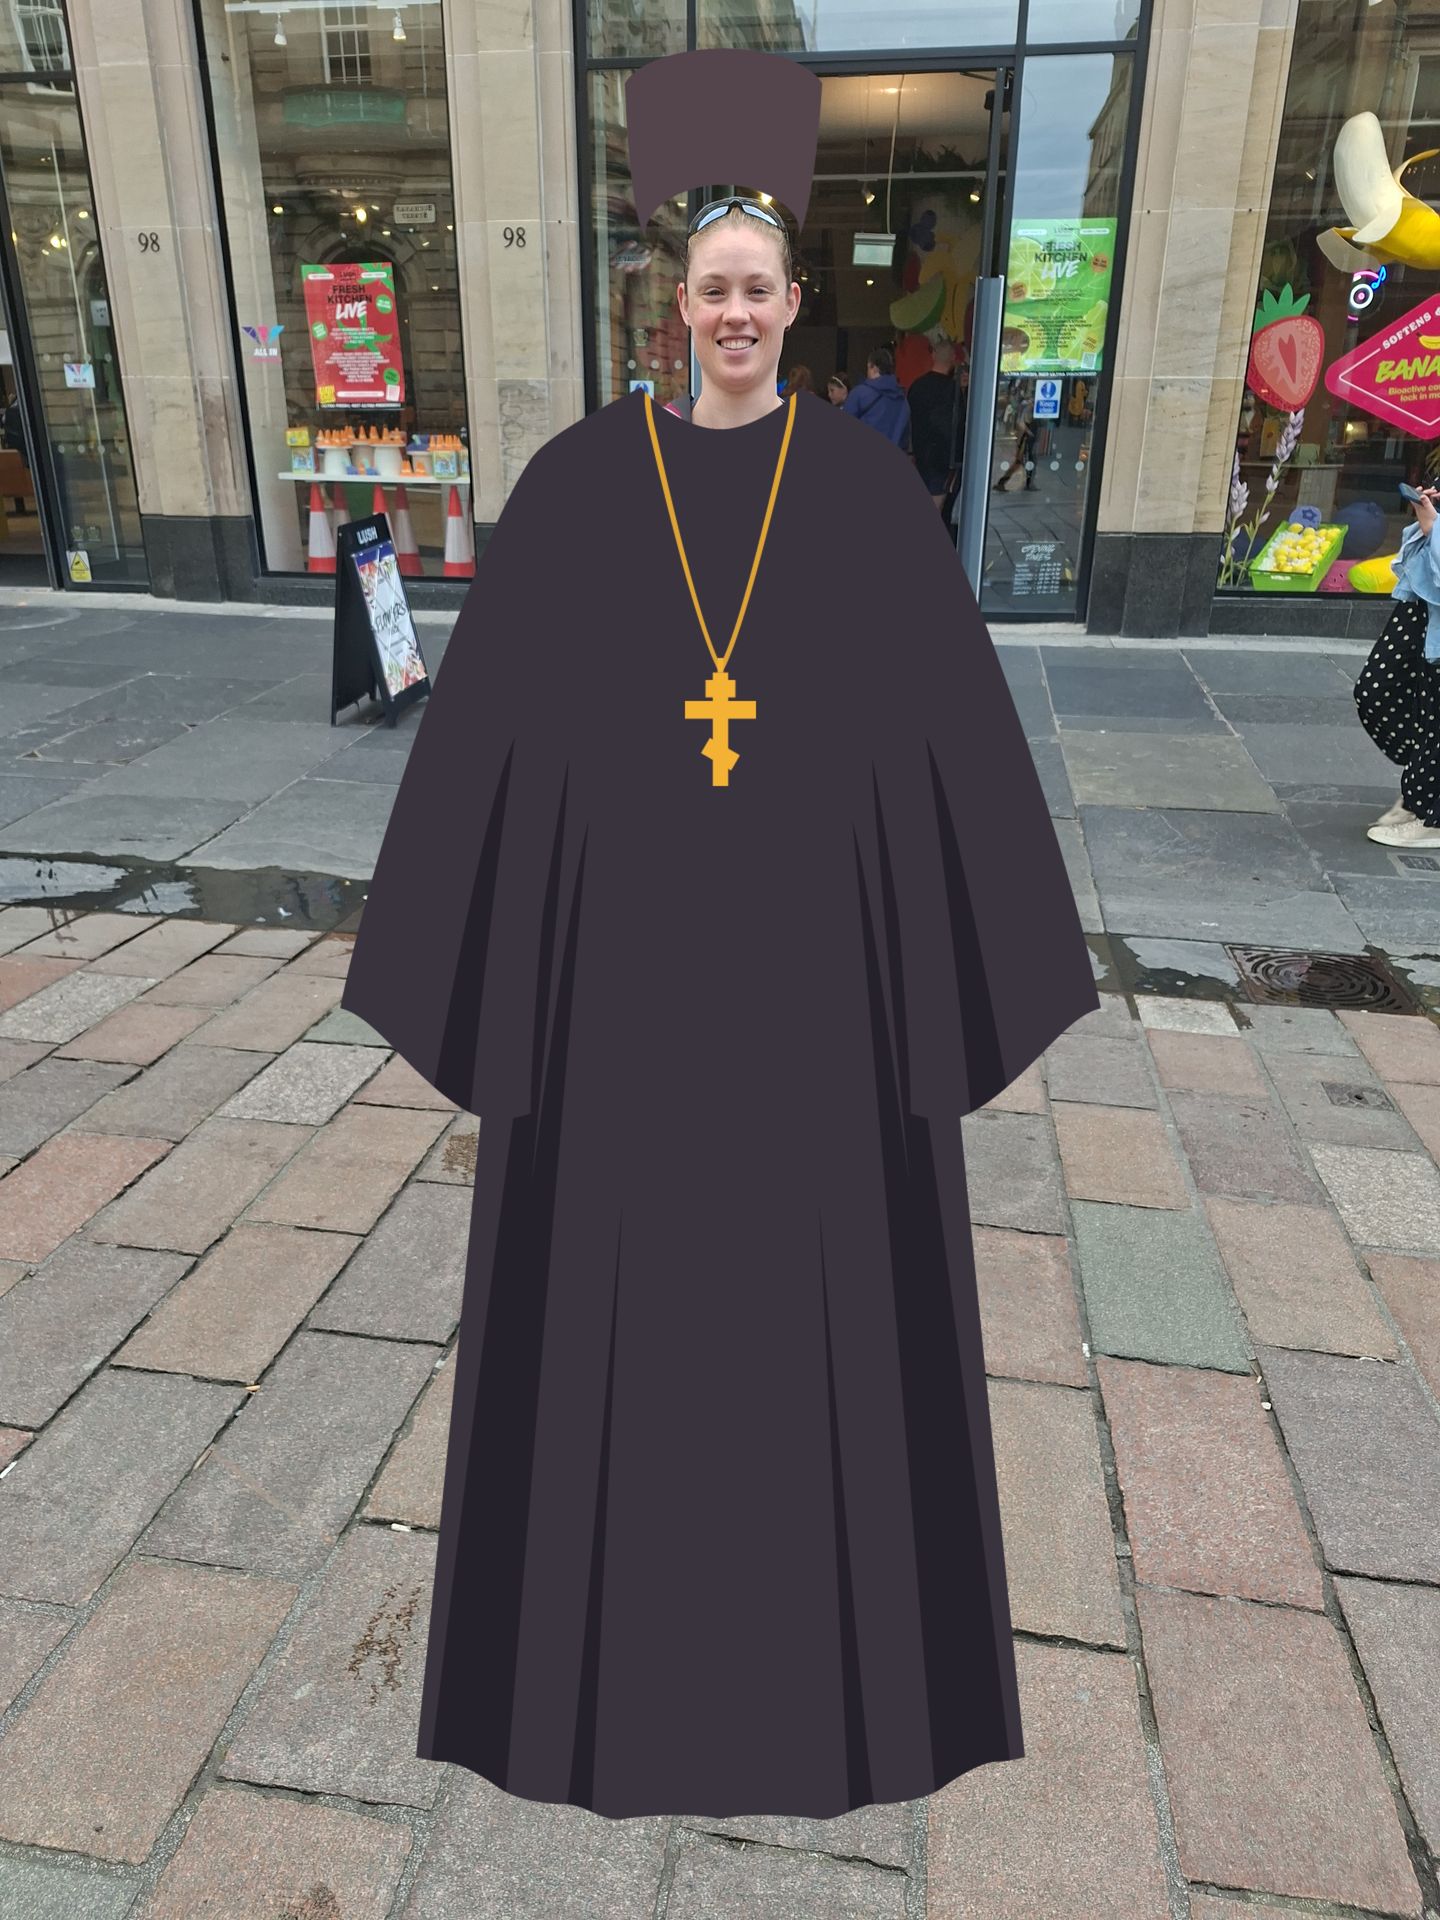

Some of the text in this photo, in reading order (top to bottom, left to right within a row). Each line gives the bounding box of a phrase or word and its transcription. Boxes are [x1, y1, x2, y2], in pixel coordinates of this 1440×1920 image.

[138, 232, 160, 253] 98
[503, 227, 526, 248] 98
[1042, 241, 1081, 252] FRESH
[1034, 252, 1087, 263] KITCHEN
[1041, 260, 1080, 280] LIVE
[332, 285, 366, 295] FRESH
[327, 294, 372, 305] KITCHEN
[335, 300, 367, 320] LIVE
[1382, 312, 1431, 350] SOFTENS
[1388, 384, 1427, 396] Bioactive
[1400, 393, 1418, 402] lock
[1419, 392, 1428, 400] in
[356, 526, 378, 544] LUSH
